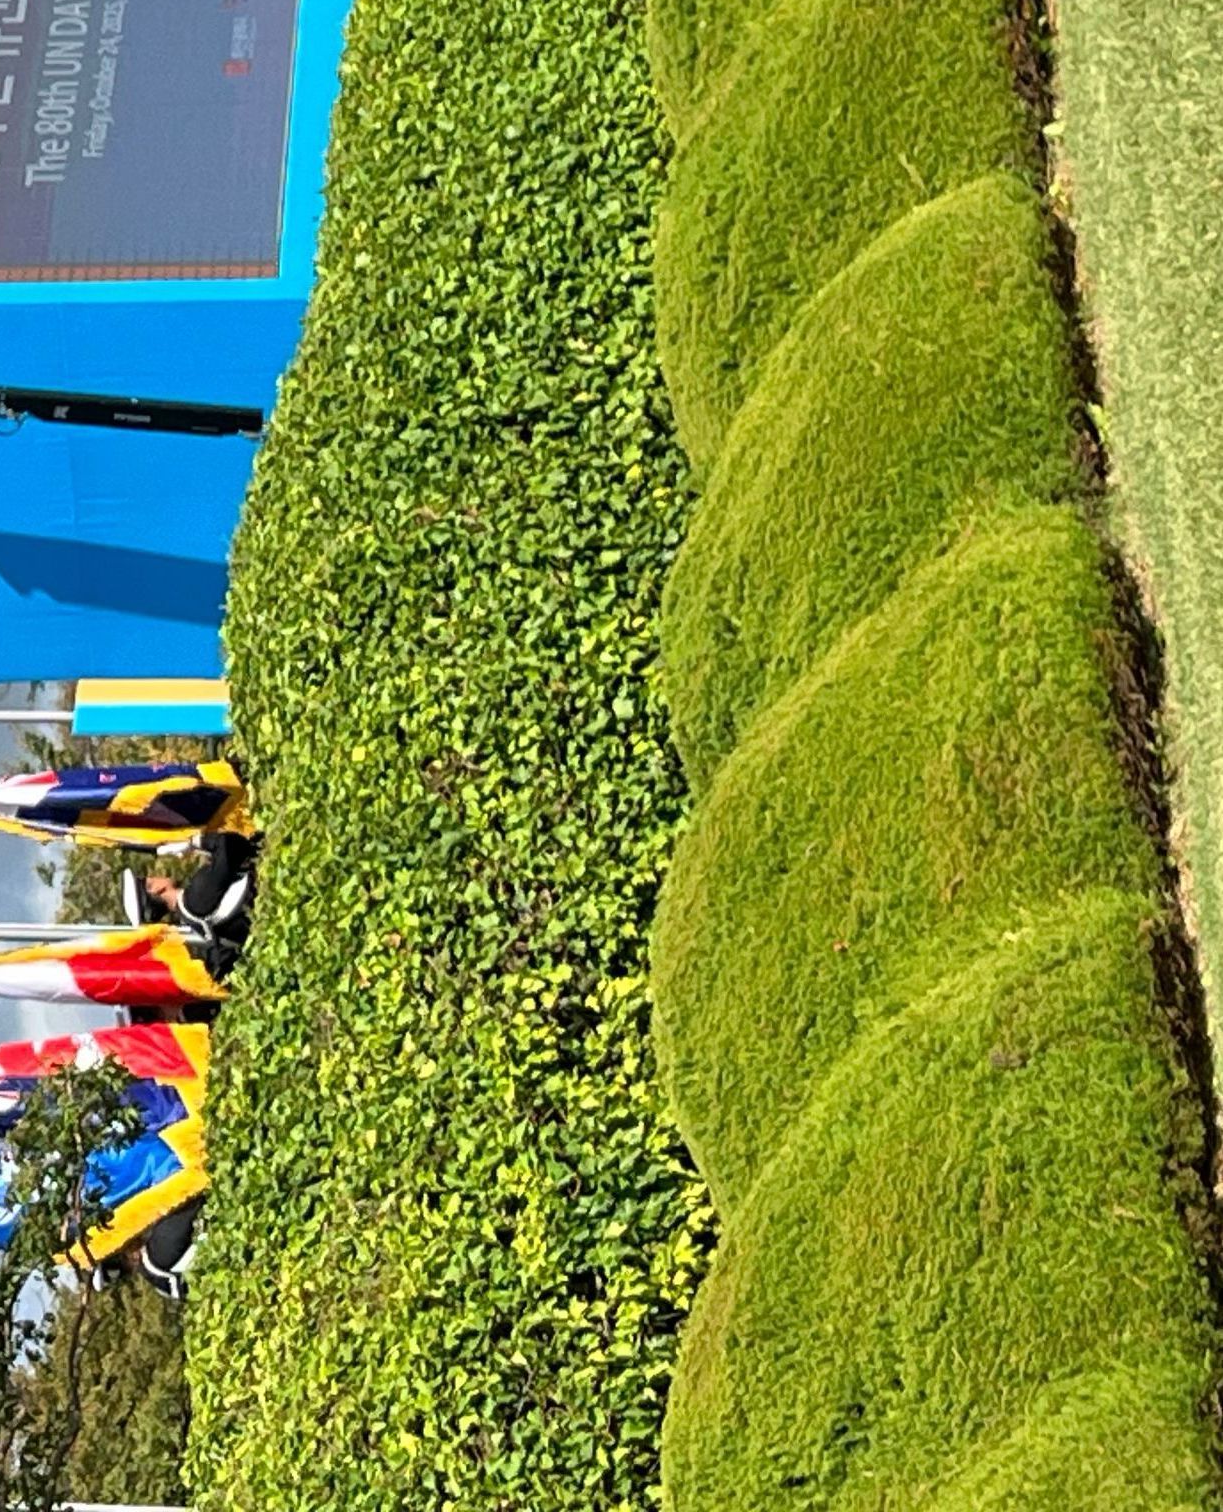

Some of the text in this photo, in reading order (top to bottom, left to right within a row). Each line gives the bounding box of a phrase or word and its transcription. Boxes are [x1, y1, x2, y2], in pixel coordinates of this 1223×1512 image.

[42, 41, 85, 76] UN
[34, 81, 79, 136] 80th
[25, 139, 70, 187] The
